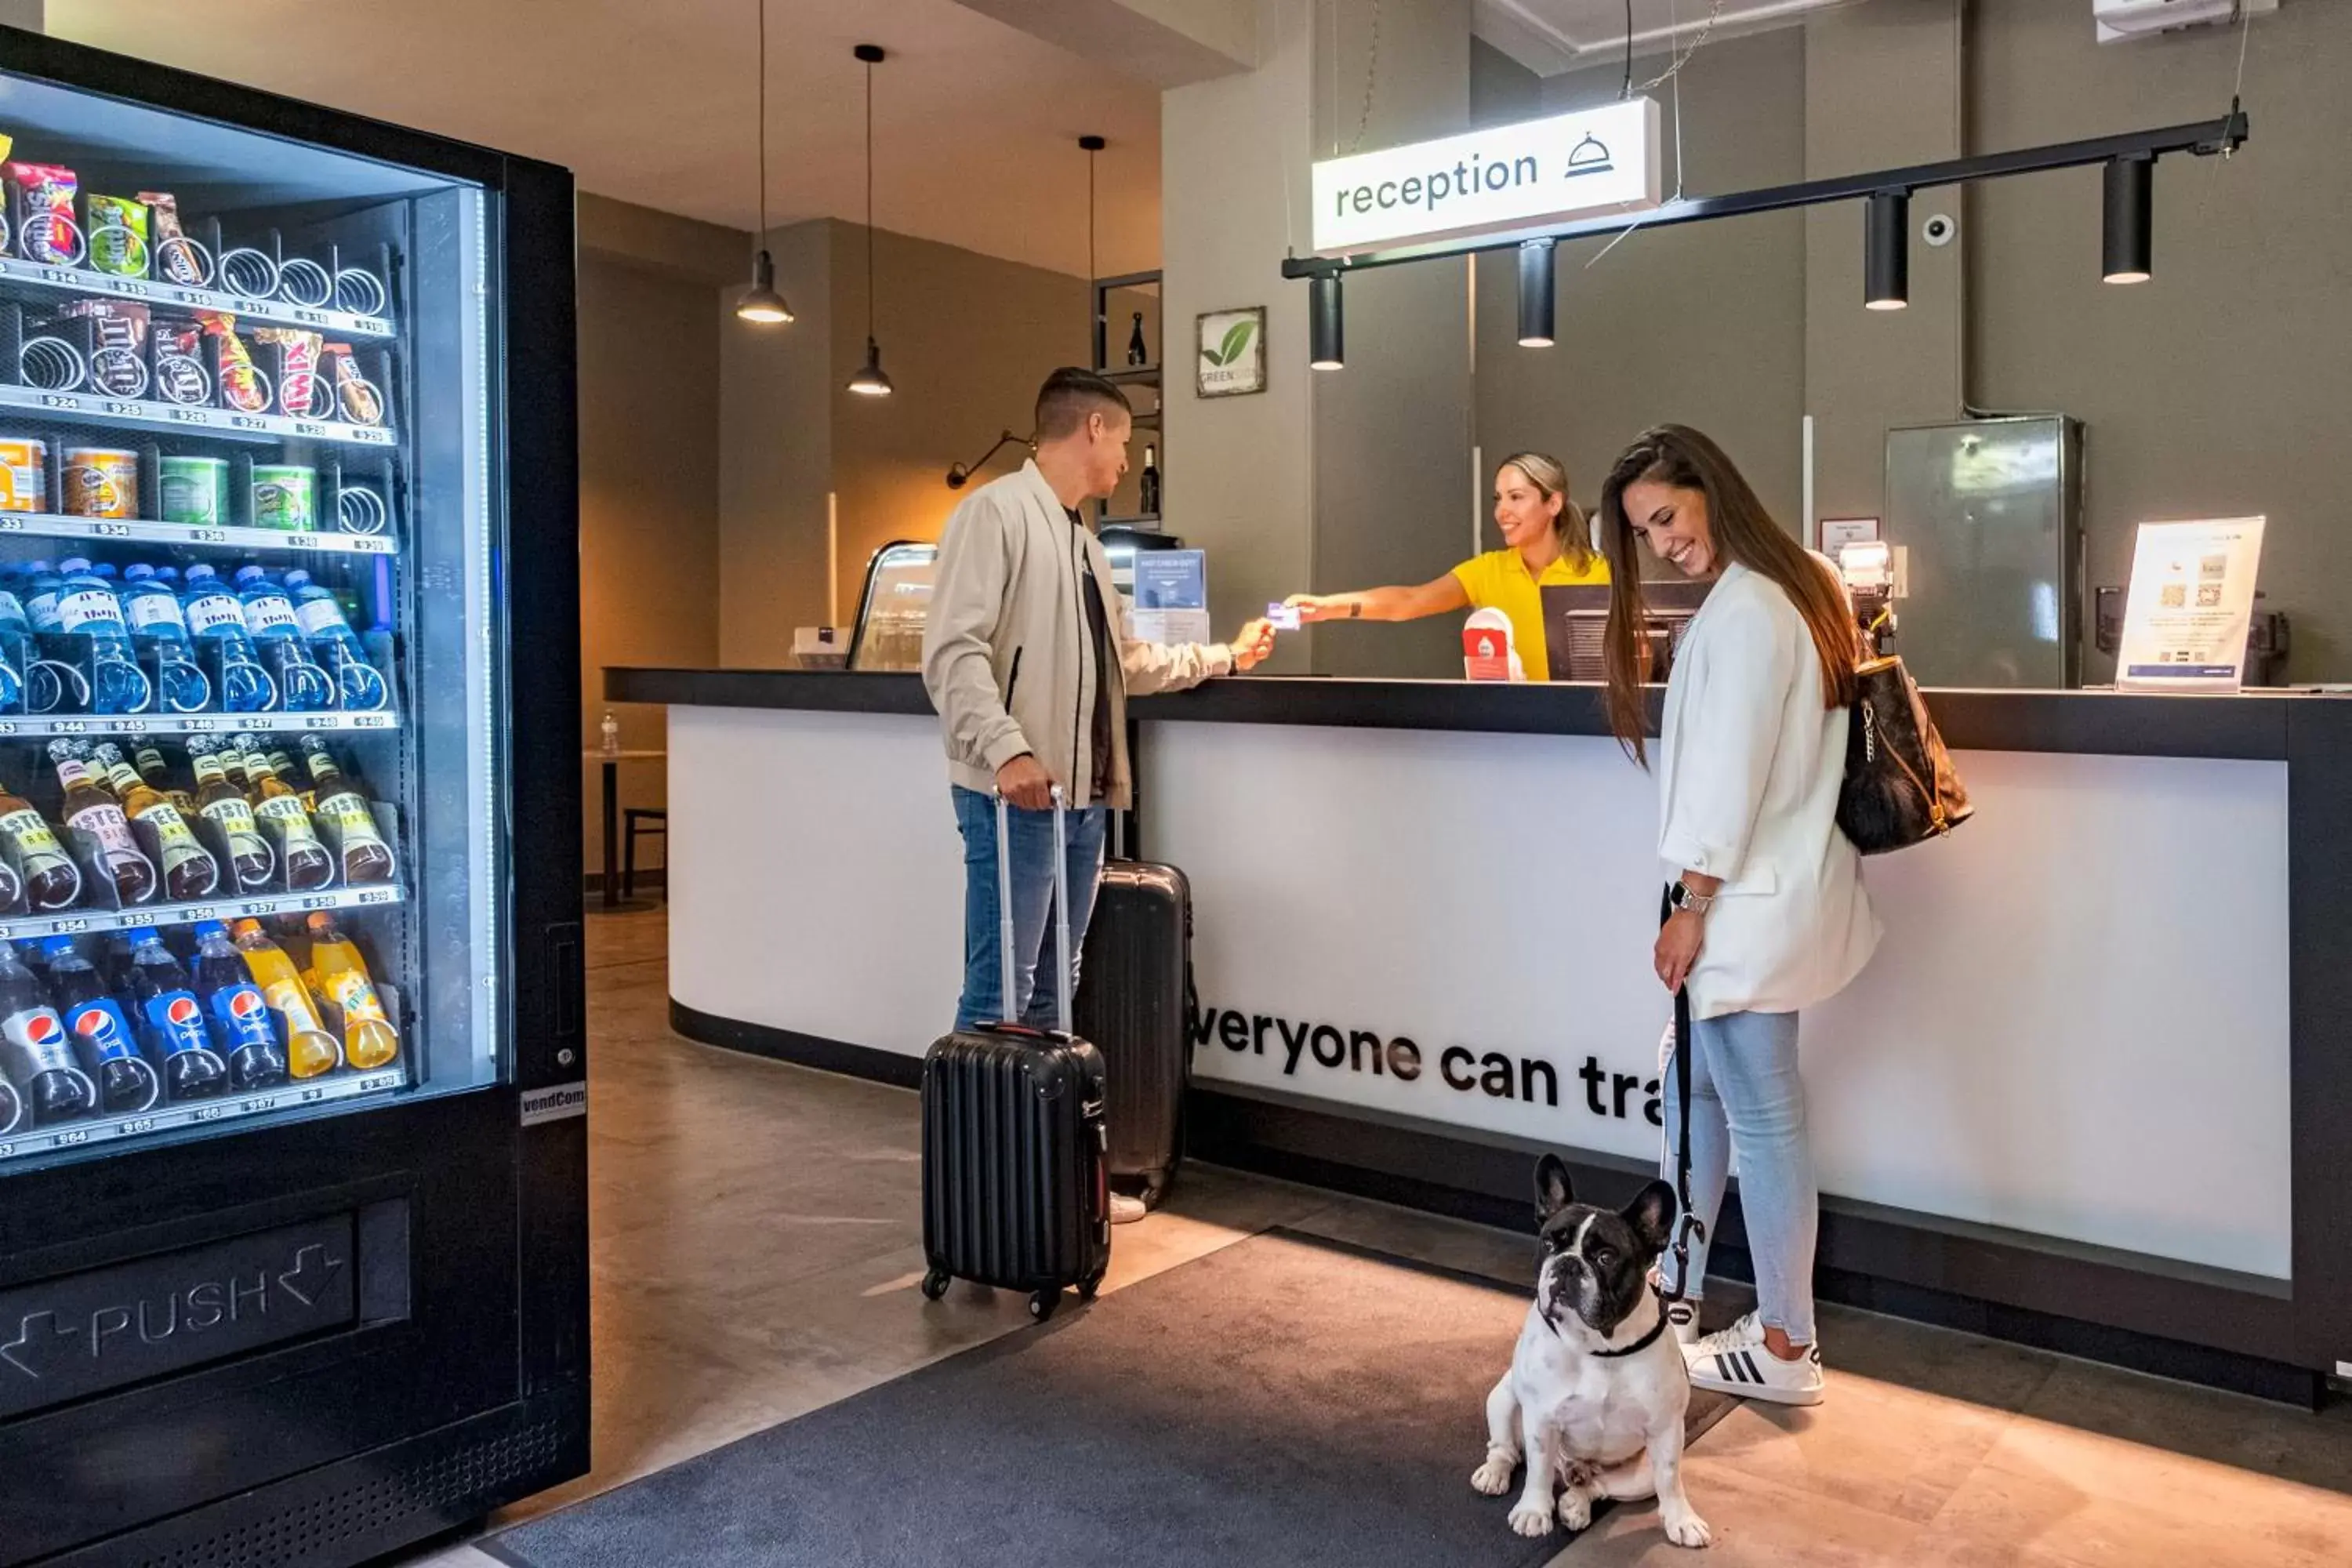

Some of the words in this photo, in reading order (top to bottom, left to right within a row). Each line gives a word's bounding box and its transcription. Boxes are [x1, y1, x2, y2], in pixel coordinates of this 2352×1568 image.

[1336, 153, 1537, 218] reception
[46, 396, 78, 408] 924
[0, 517, 22, 529] 33
[55, 721, 85, 733] 944
[115, 721, 146, 732] 945
[245, 718, 271, 729] 947
[57, 920, 86, 932] 954
[124, 914, 154, 926] 955
[1192, 1007, 1421, 1081] veryone
[1440, 1044, 1559, 1107] can
[1578, 1055, 1662, 1127] tra
[248, 1098, 274, 1111] 967
[523, 1091, 584, 1112] vendCom
[59, 1133, 87, 1144] 964
[91, 1269, 269, 1358] PUSH
